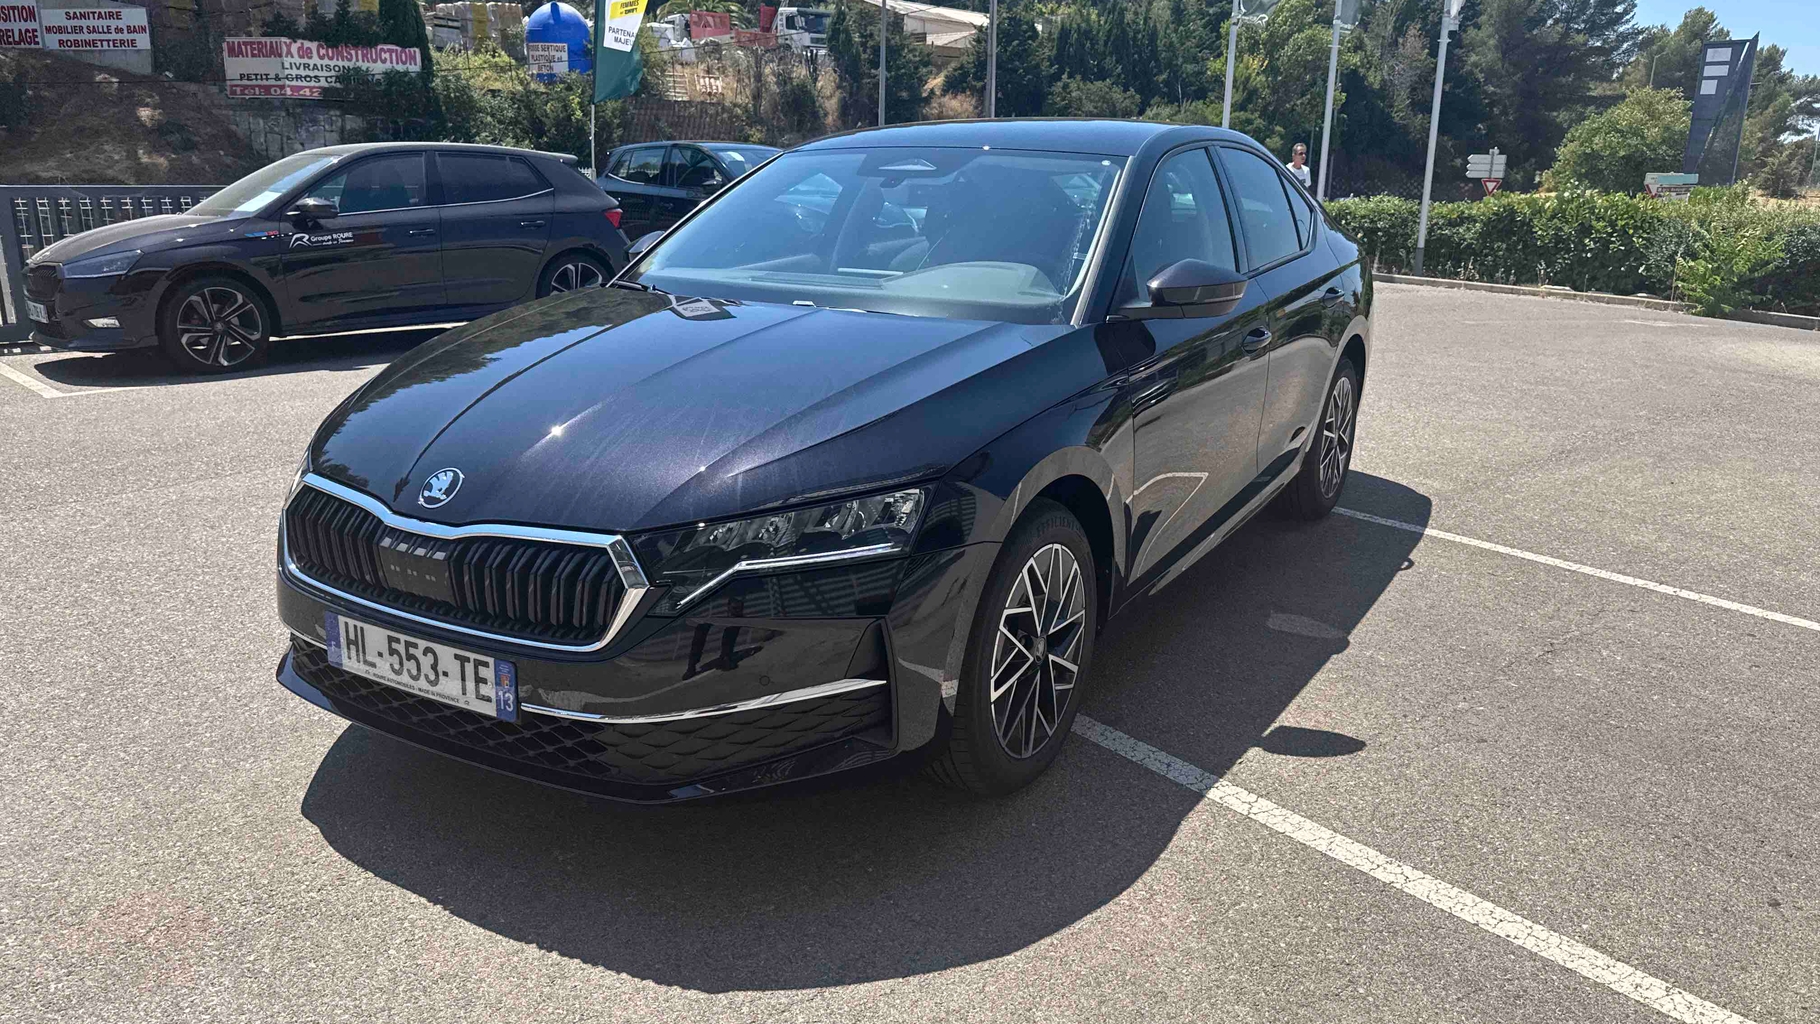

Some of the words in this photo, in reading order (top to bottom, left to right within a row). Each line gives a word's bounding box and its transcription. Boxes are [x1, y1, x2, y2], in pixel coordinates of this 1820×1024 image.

[0, 5, 37, 23] SITION
[65, 11, 123, 21] SANITAIRE
[45, 25, 85, 35] MOBILIER
[86, 25, 113, 35] SALLE
[114, 25, 125, 35] de
[126, 25, 147, 35] BAIN
[608, 26, 635, 38] PARTENA
[58, 39, 138, 48] ROBINETTERIE
[226, 40, 294, 59] MATERIAUX
[296, 42, 314, 60] de
[316, 42, 418, 67] CONSTRUCTION
[281, 61, 351, 75] LIVRAISON
[239, 73, 270, 82] PETIT
[274, 73, 282, 82] &
[285, 73, 322, 84] GROS
[332, 231, 353, 239] ROURE
[344, 621, 493, 704] HL-553-TE
[499, 690, 514, 712] 13
